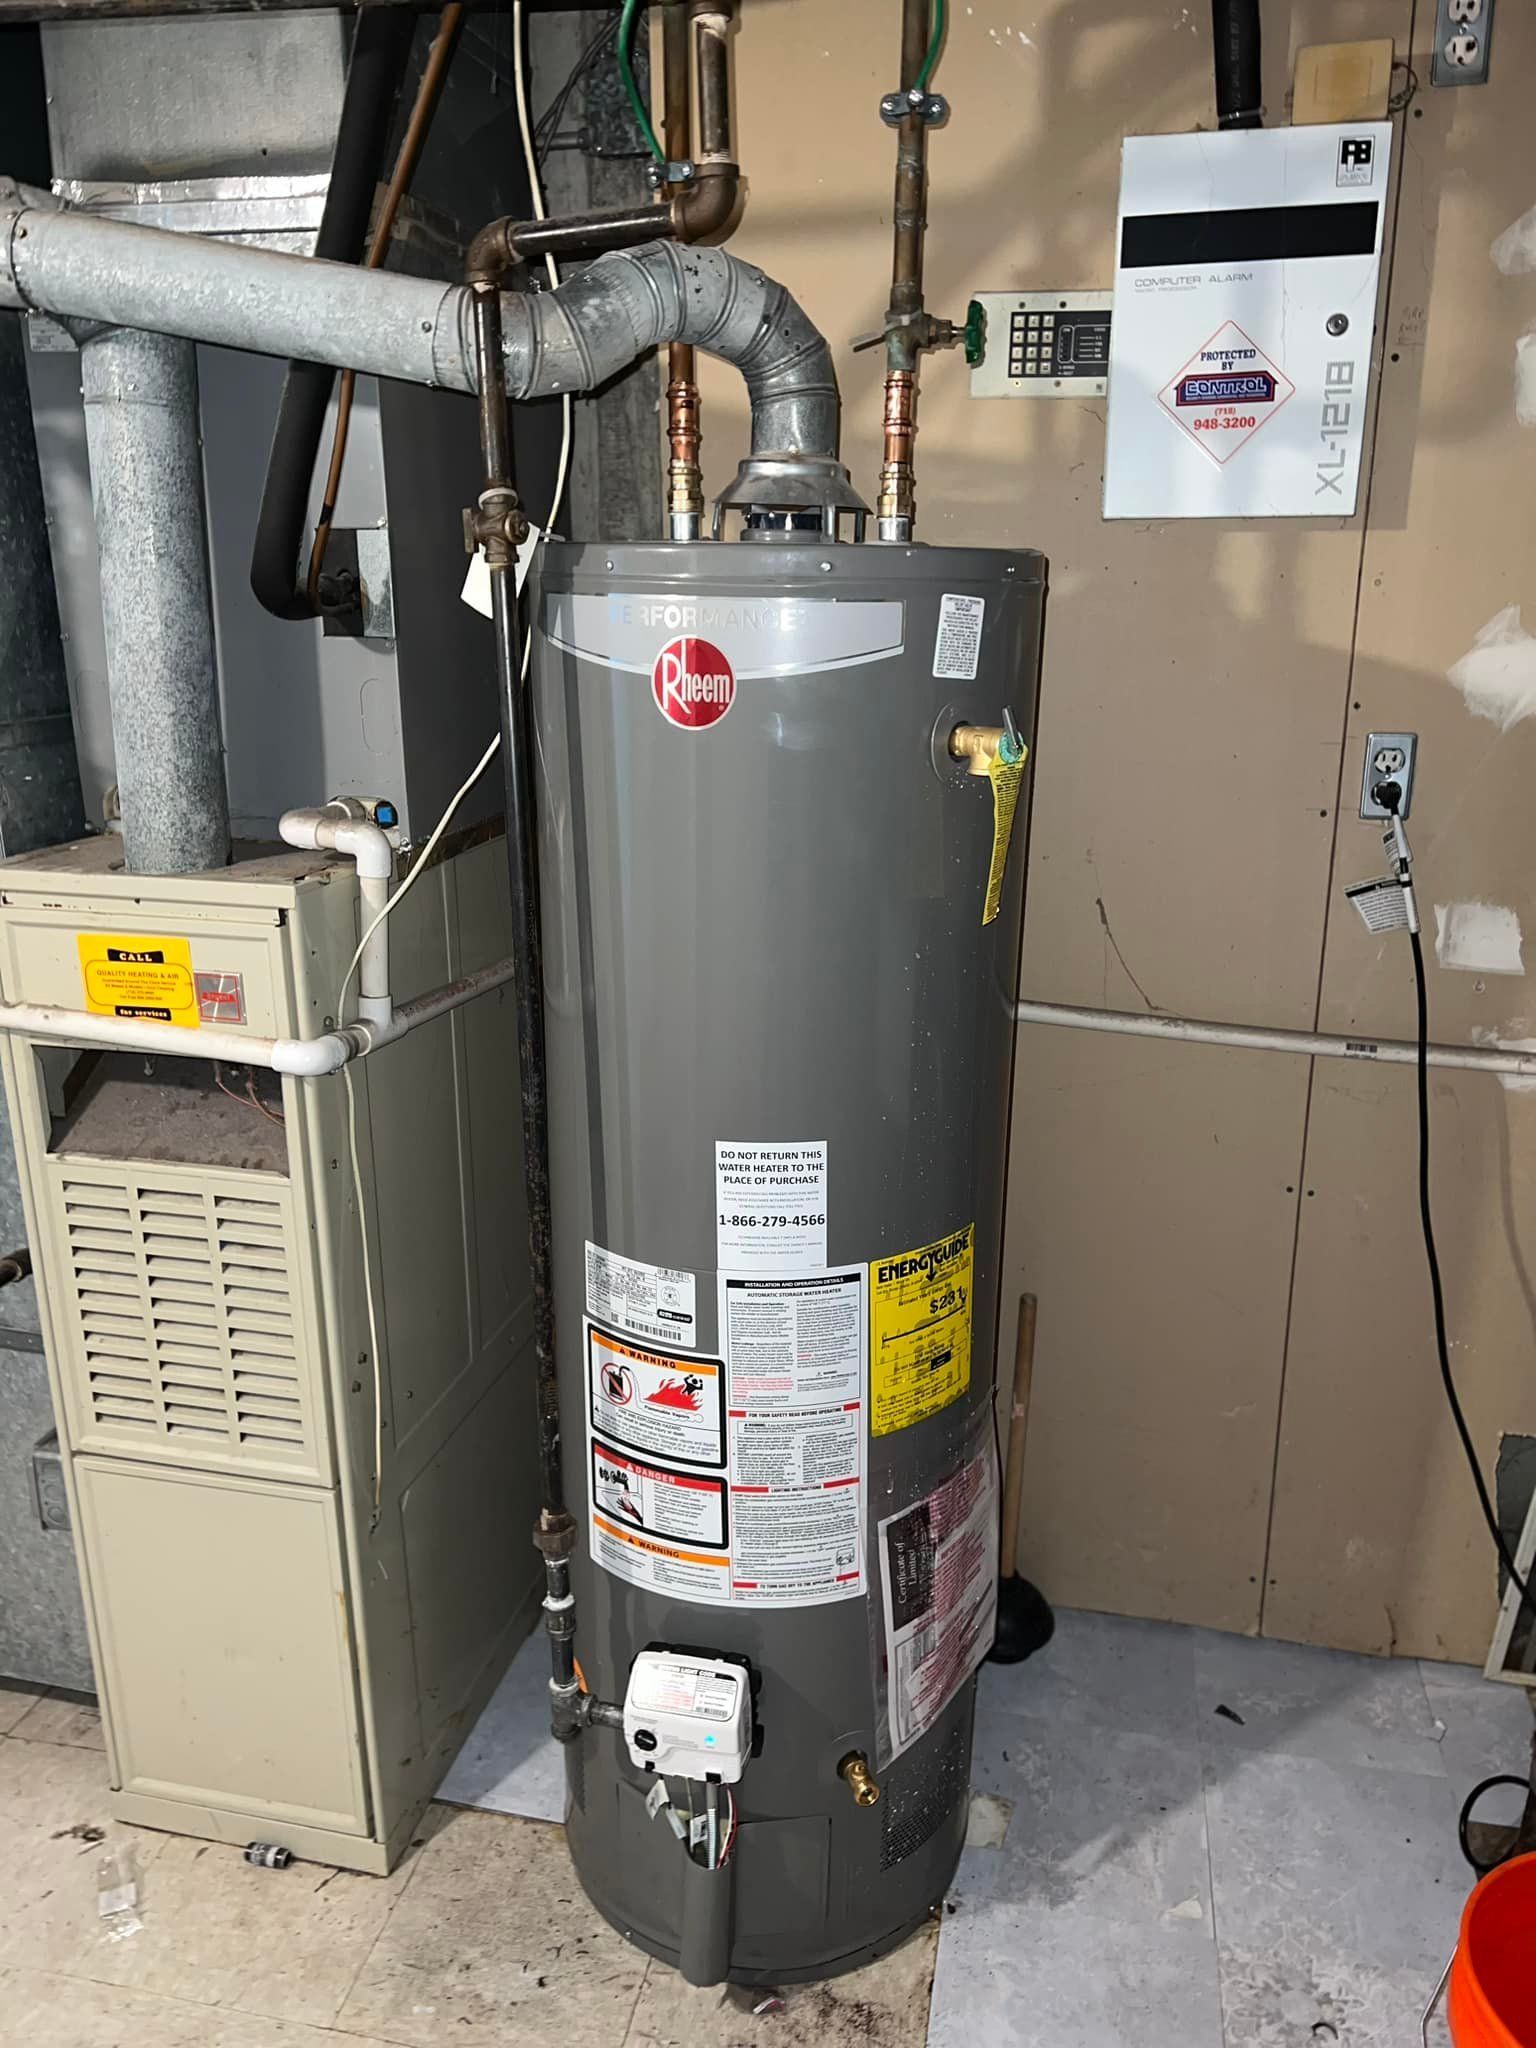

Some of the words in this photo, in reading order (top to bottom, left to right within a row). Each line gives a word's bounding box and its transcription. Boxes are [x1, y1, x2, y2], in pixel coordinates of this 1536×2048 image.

[1135, 276, 1201, 287] COMPUTER
[1209, 273, 1253, 283] ALARM
[1201, 349, 1256, 361] PROTECTED
[1222, 361, 1234, 371] BY
[1186, 377, 1267, 396] CONTROL
[1215, 407, 1236, 416] (718)
[1194, 417, 1256, 430] 948-3200
[662, 639, 729, 714] Rheem
[119, 953, 152, 962] CALL
[97, 969, 126, 977] QUALITY
[721, 1151, 735, 1159] DO
[738, 1152, 758, 1160] NOT
[760, 1152, 798, 1160] RETURN
[801, 1151, 822, 1159] THIS
[719, 1163, 751, 1172] WATER
[753, 1164, 789, 1173] HEATER
[791, 1164, 804, 1172] TO
[806, 1163, 824, 1171] THE
[724, 1176, 752, 1185] PLACE
[755, 1177, 767, 1185] OF
[769, 1176, 819, 1185] PURCHASE
[719, 1214, 825, 1227] 1-866-279-4566
[879, 1232, 969, 1284] ENERGYGUIDE
[629, 1349, 676, 1369] WARNING
[818, 1407, 842, 1415] OPERATING
[635, 1465, 676, 1484] DANGER
[639, 1539, 680, 1558] WARNING
[907, 1549, 917, 1585] Limited
[897, 1554, 907, 1603] Certificate
